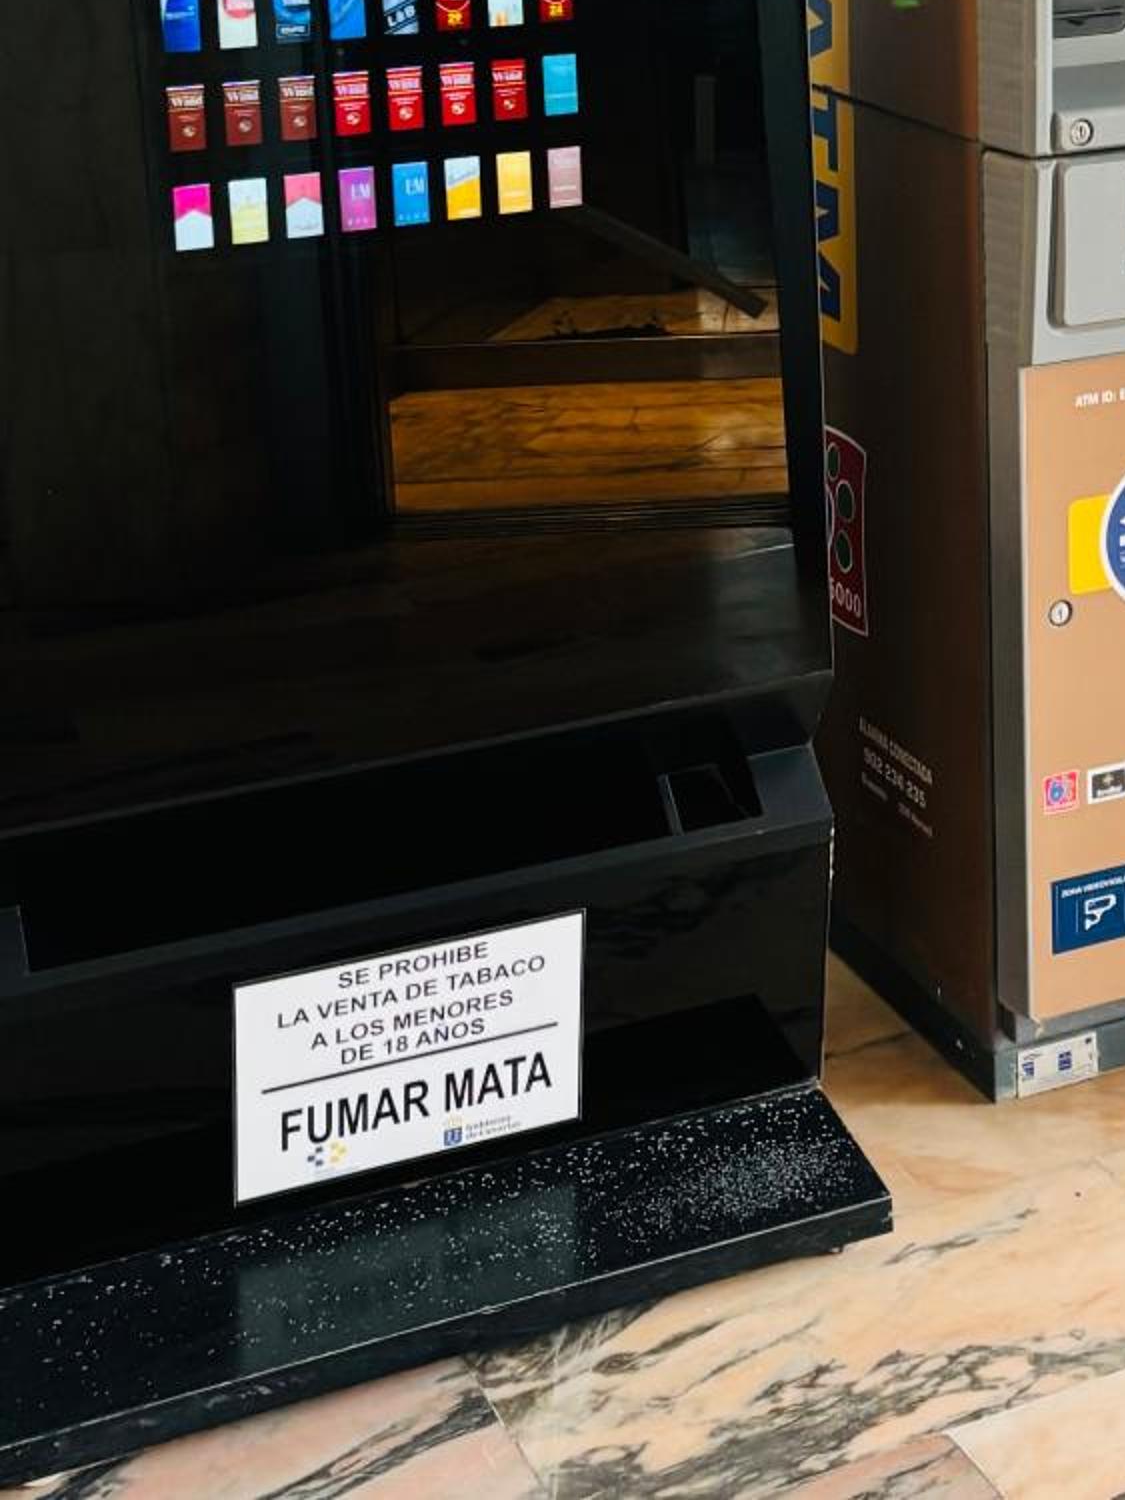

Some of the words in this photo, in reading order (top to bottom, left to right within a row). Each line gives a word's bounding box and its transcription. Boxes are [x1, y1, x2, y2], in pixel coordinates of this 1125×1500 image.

[277, 1008, 311, 1029] LA
[316, 987, 399, 1021] VENTA
[405, 980, 438, 1001] DE
[446, 955, 546, 992] TABACO
[338, 967, 370, 990] SE
[378, 941, 490, 980] PROHIBE
[311, 1032, 329, 1051] A
[335, 1019, 385, 1045] LOS
[393, 989, 514, 1032] MENORES
[340, 1045, 374, 1066] DE
[384, 1035, 409, 1056] 18
[415, 1016, 486, 1049] AÑOS
[280, 1079, 430, 1152] FUMAR
[444, 1051, 552, 1112] MATA
